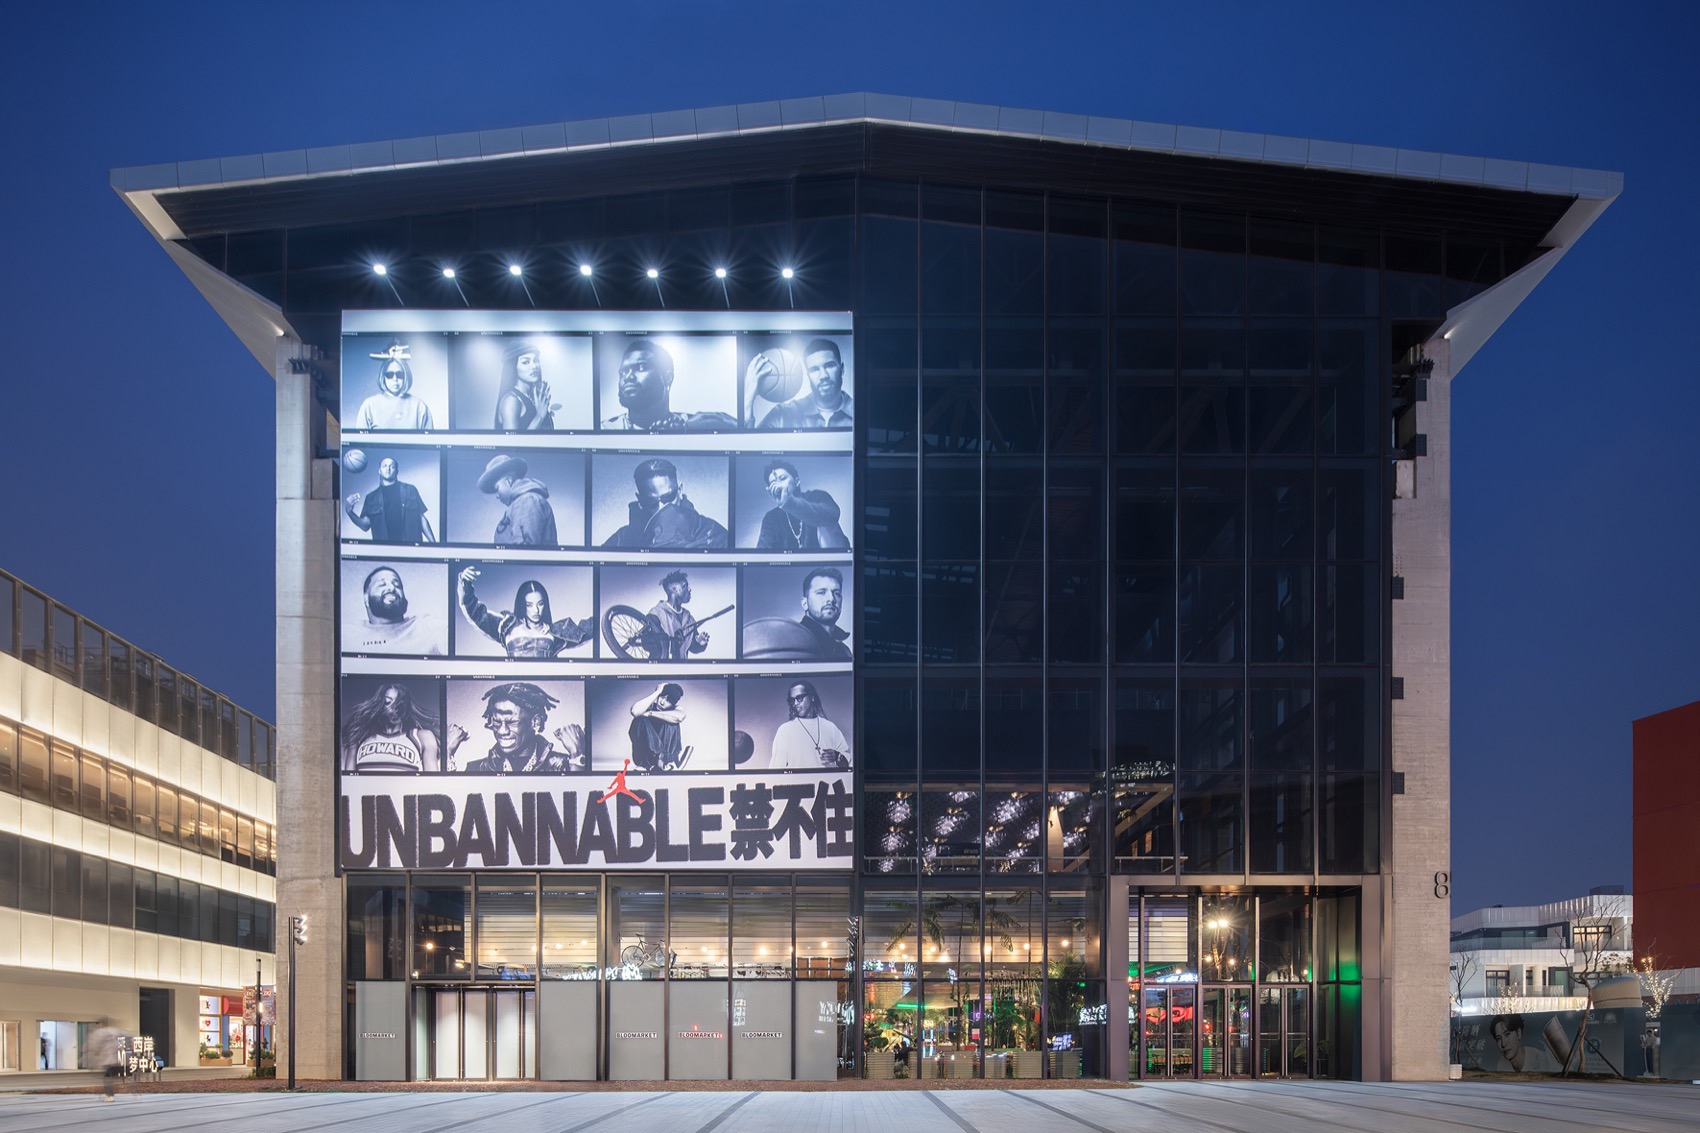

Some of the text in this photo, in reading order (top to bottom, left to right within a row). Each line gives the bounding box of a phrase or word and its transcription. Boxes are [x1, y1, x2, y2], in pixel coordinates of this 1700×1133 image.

[359, 742, 415, 763] HOWARD
[342, 780, 853, 868] UNBANNABLE 禁不住
[1434, 871, 1448, 899] 8
[133, 1036, 154, 1057] 西岸
[129, 1056, 159, 1073] 梦中心
